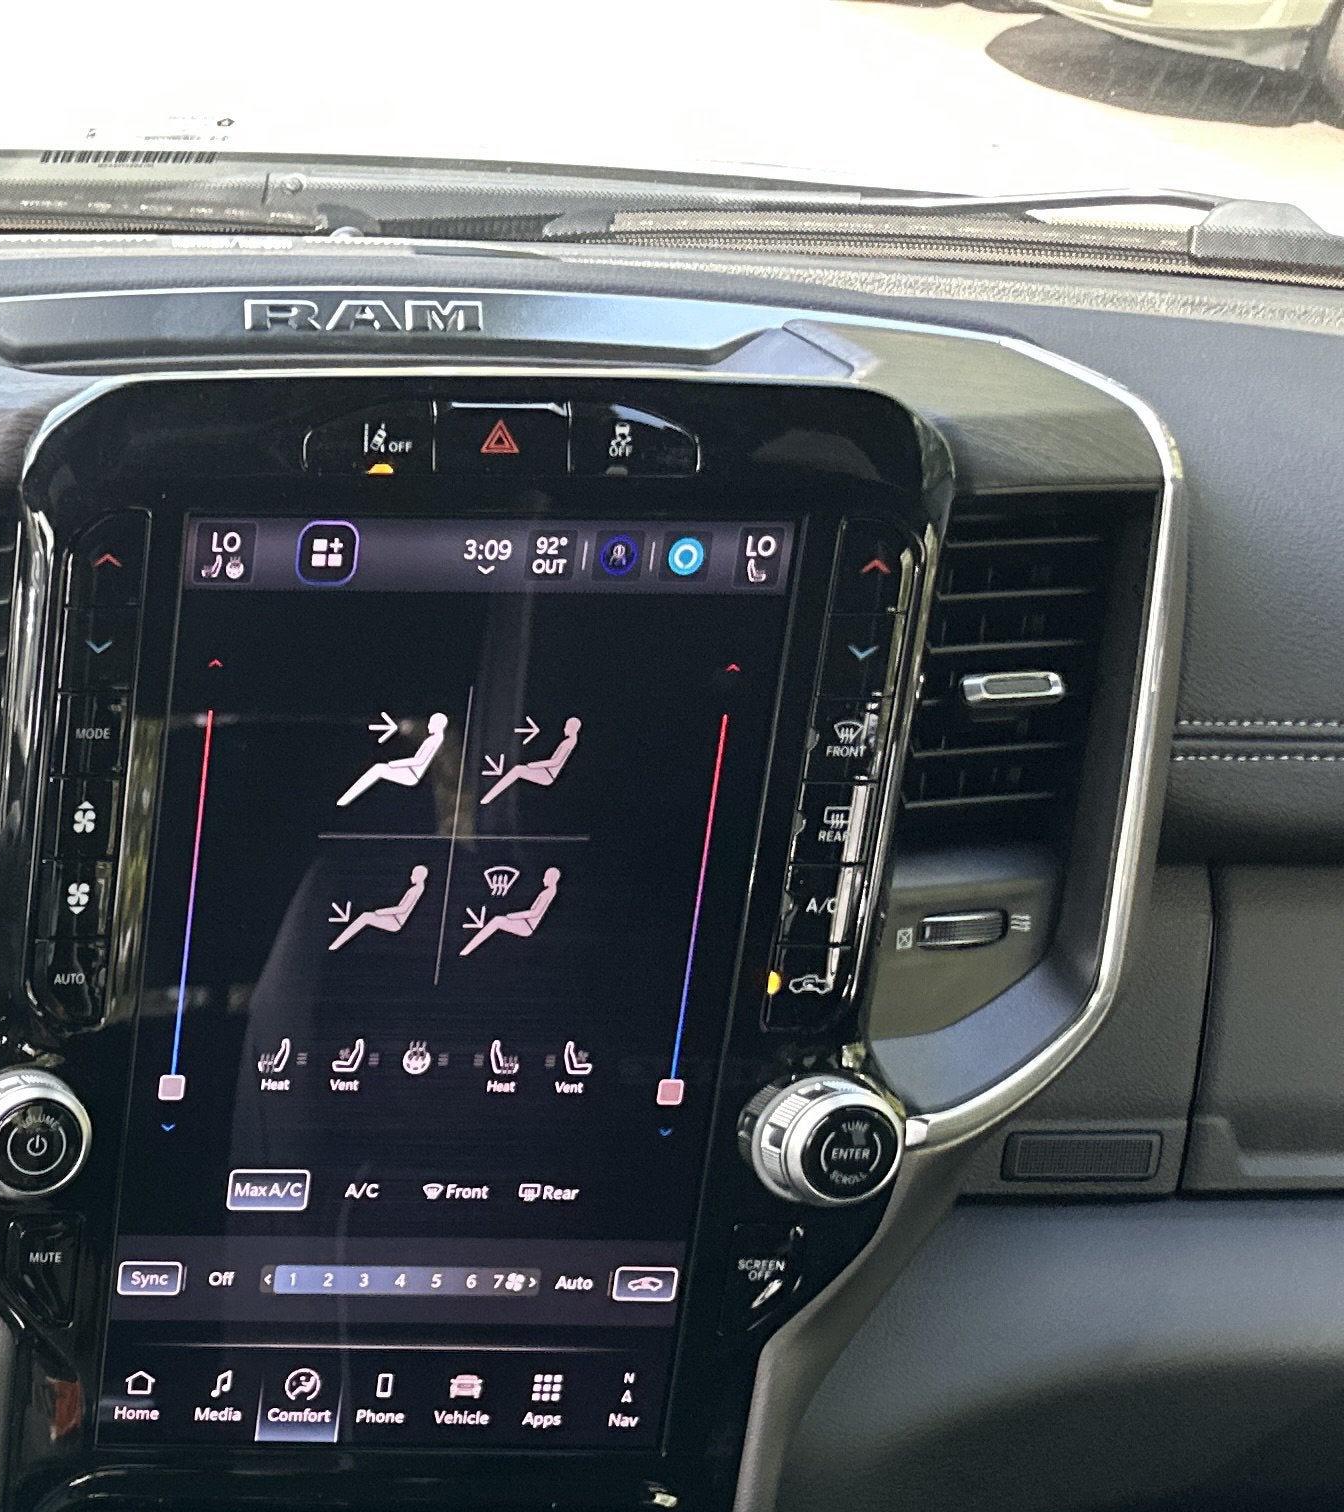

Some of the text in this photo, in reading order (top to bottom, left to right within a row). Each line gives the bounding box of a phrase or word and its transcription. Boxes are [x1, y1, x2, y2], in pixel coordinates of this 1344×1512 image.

[244, 299, 483, 332] RAM
[388, 441, 413, 454] OFF
[608, 446, 634, 458] OFF
[212, 532, 242, 553] LO
[464, 539, 513, 561] 3:09
[535, 536, 569, 556] 92°
[746, 535, 777, 557] LO
[532, 559, 568, 574] OUT
[75, 728, 111, 741] MODE
[825, 744, 867, 759] FRONT
[805, 898, 838, 914] A/C
[54, 972, 86, 986] AUTO
[259, 1078, 291, 1092] Heat
[329, 1079, 360, 1092] Vent
[486, 1080, 516, 1093] Heat
[554, 1081, 584, 1094] Vent
[841, 1120, 870, 1134] TUNE
[831, 1148, 871, 1161] ENTER
[344, 1182, 380, 1199] A/C
[445, 1184, 490, 1200] Front
[542, 1185, 580, 1201] Rear
[29, 1252, 62, 1264] MUTE
[737, 1259, 786, 1272] SCREEN
[130, 1271, 169, 1288] Sync
[208, 1271, 236, 1286] Off
[289, 1272, 505, 1289] 1 2 3 4 5 6 7
[554, 1275, 594, 1290] Auto
[748, 1270, 772, 1282] OFF
[113, 1406, 160, 1421] Home
[194, 1406, 242, 1422] Media
[267, 1407, 332, 1423] Comfort
[355, 1409, 405, 1425] Phone
[434, 1410, 491, 1426] Vehicle
[521, 1411, 562, 1429] Apps
[608, 1412, 640, 1429] Nav
